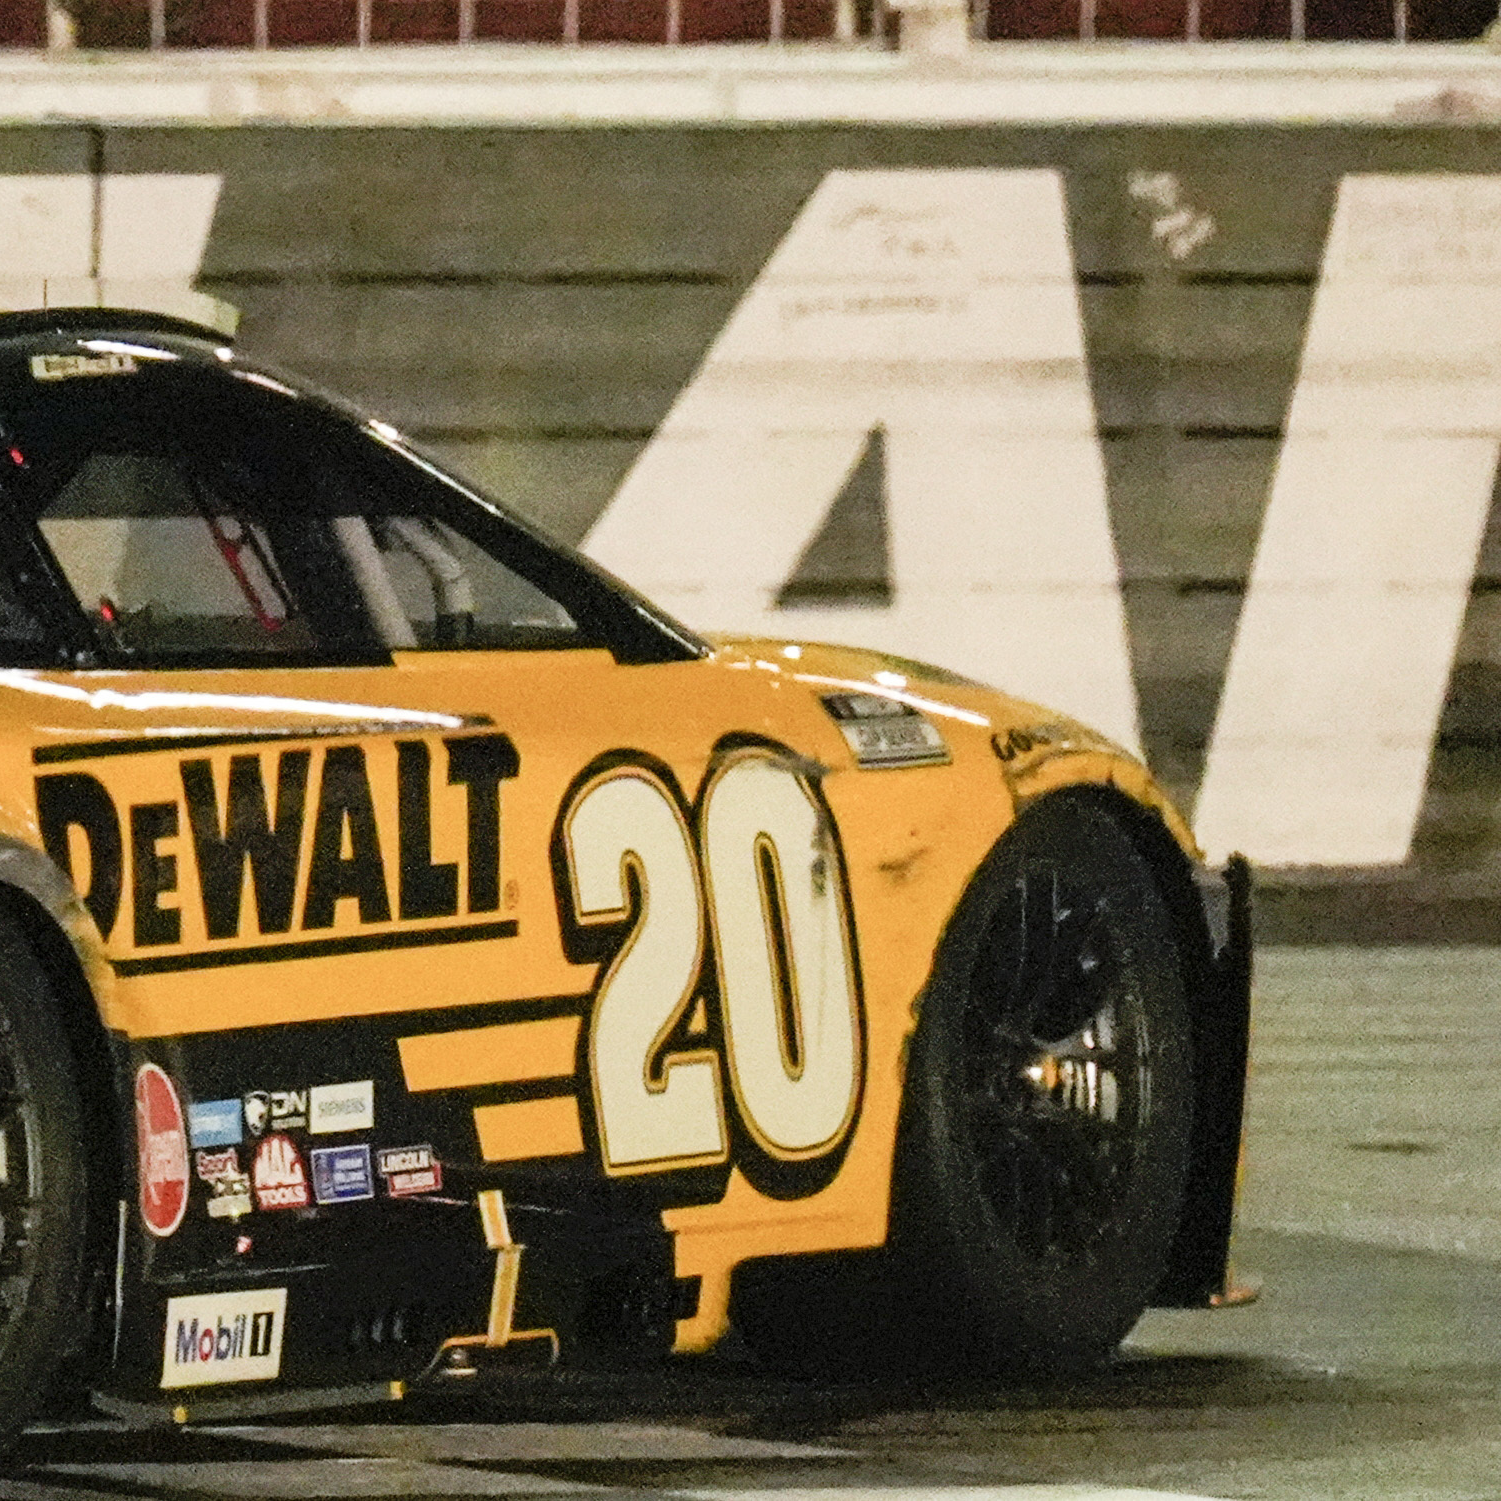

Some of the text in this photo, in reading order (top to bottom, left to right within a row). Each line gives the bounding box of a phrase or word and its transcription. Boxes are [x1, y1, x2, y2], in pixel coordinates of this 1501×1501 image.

[559, 738, 865, 1188] 20
[381, 1149, 430, 1173] LINCOLN
[174, 1312, 248, 1365] Mobil
